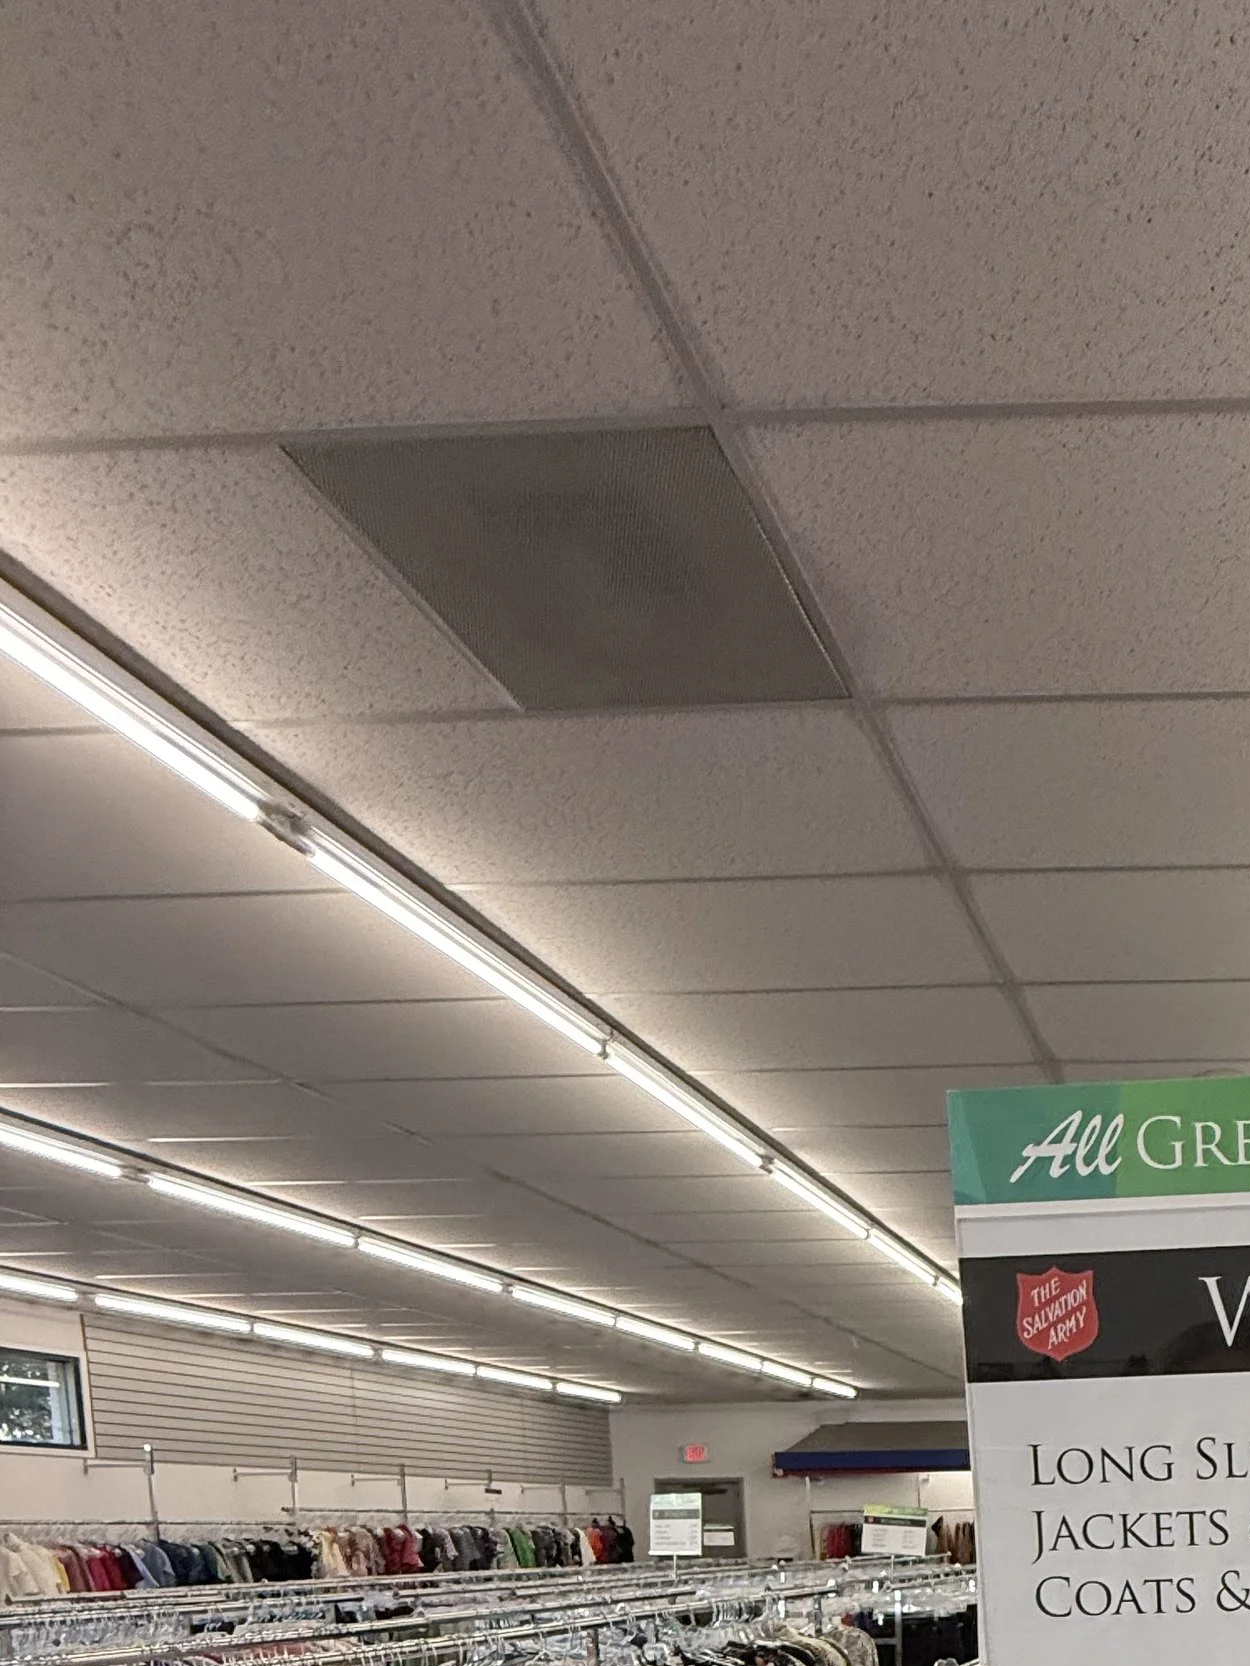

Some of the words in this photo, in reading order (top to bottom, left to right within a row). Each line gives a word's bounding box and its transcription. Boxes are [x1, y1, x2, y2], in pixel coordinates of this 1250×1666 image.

[1010, 1109, 1124, 1183] All
[1022, 1280, 1088, 1339] SALVATION
[1031, 1277, 1061, 1307] THE
[1047, 1305, 1087, 1350] ARMY
[1027, 1443, 1175, 1486] LONG
[1031, 1508, 1230, 1565] JACKETS
[1034, 1575, 1197, 1618] COATS
